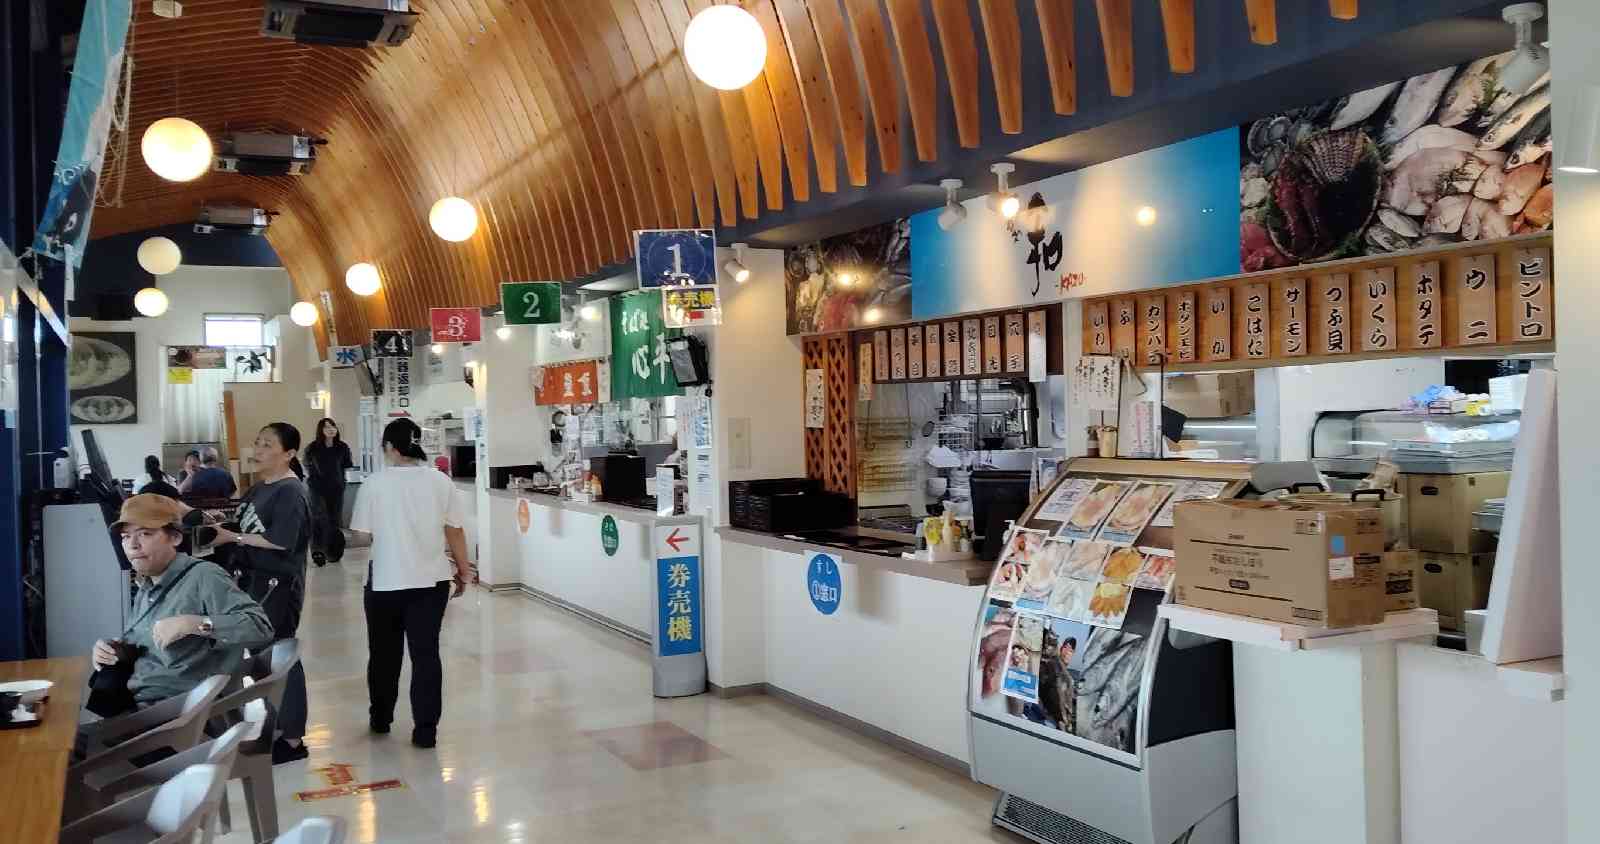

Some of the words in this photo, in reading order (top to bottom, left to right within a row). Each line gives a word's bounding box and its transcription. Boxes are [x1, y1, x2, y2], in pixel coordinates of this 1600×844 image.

[666, 243, 691, 279] 1
[1027, 191, 1063, 297] 和
[448, 315, 464, 337] 3
[522, 291, 542, 319] 2
[1212, 300, 1225, 355] いか
[1286, 288, 1302, 353] サーモン
[1369, 280, 1388, 348] いくら
[1417, 275, 1435, 345] ホタテ
[1465, 269, 1489, 339] ウニ
[336, 347, 358, 364] 水
[384, 335, 399, 353] 4
[815, 560, 833, 575] すし
[667, 563, 693, 642] 券売機
